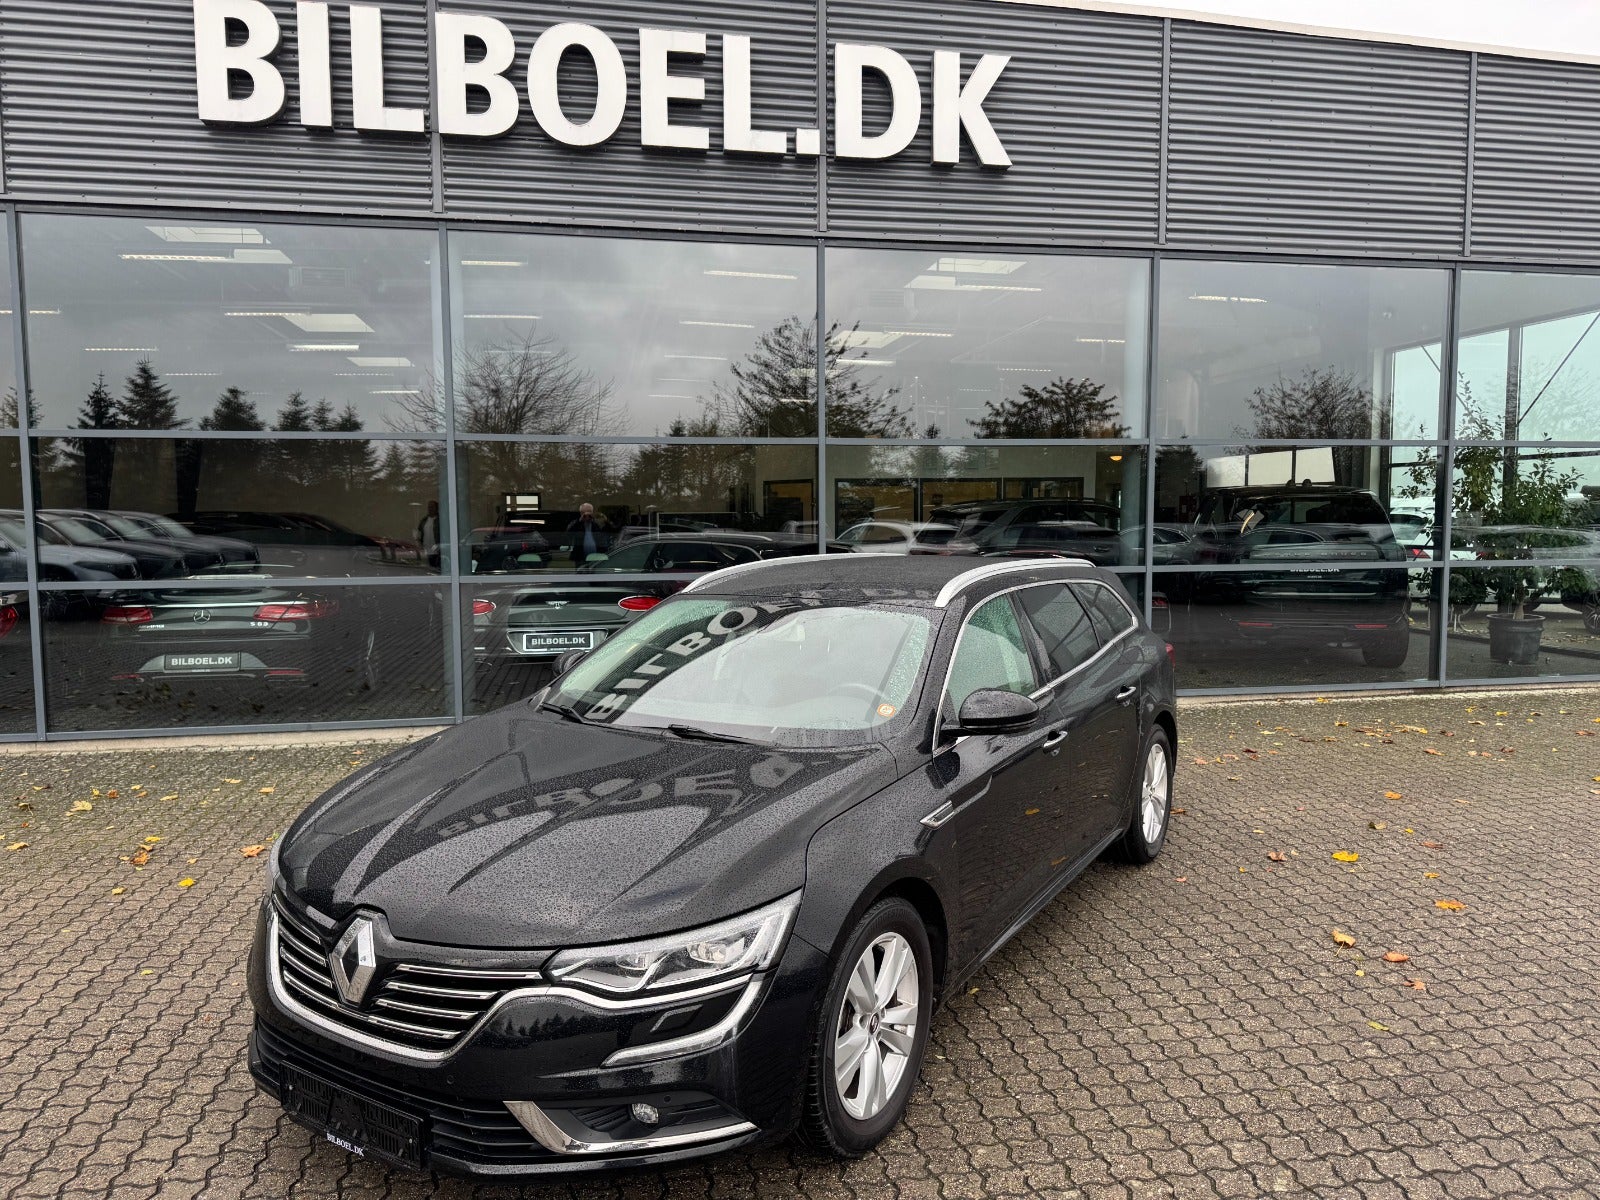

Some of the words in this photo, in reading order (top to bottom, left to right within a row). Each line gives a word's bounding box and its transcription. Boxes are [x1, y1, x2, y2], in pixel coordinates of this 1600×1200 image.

[193, 0, 1013, 169] BILBOEL.DK
[531, 637, 586, 645] BILBOEL.DK
[171, 656, 233, 666] BILBOEL.DK
[326, 1132, 364, 1157] BILBOEL.DK
